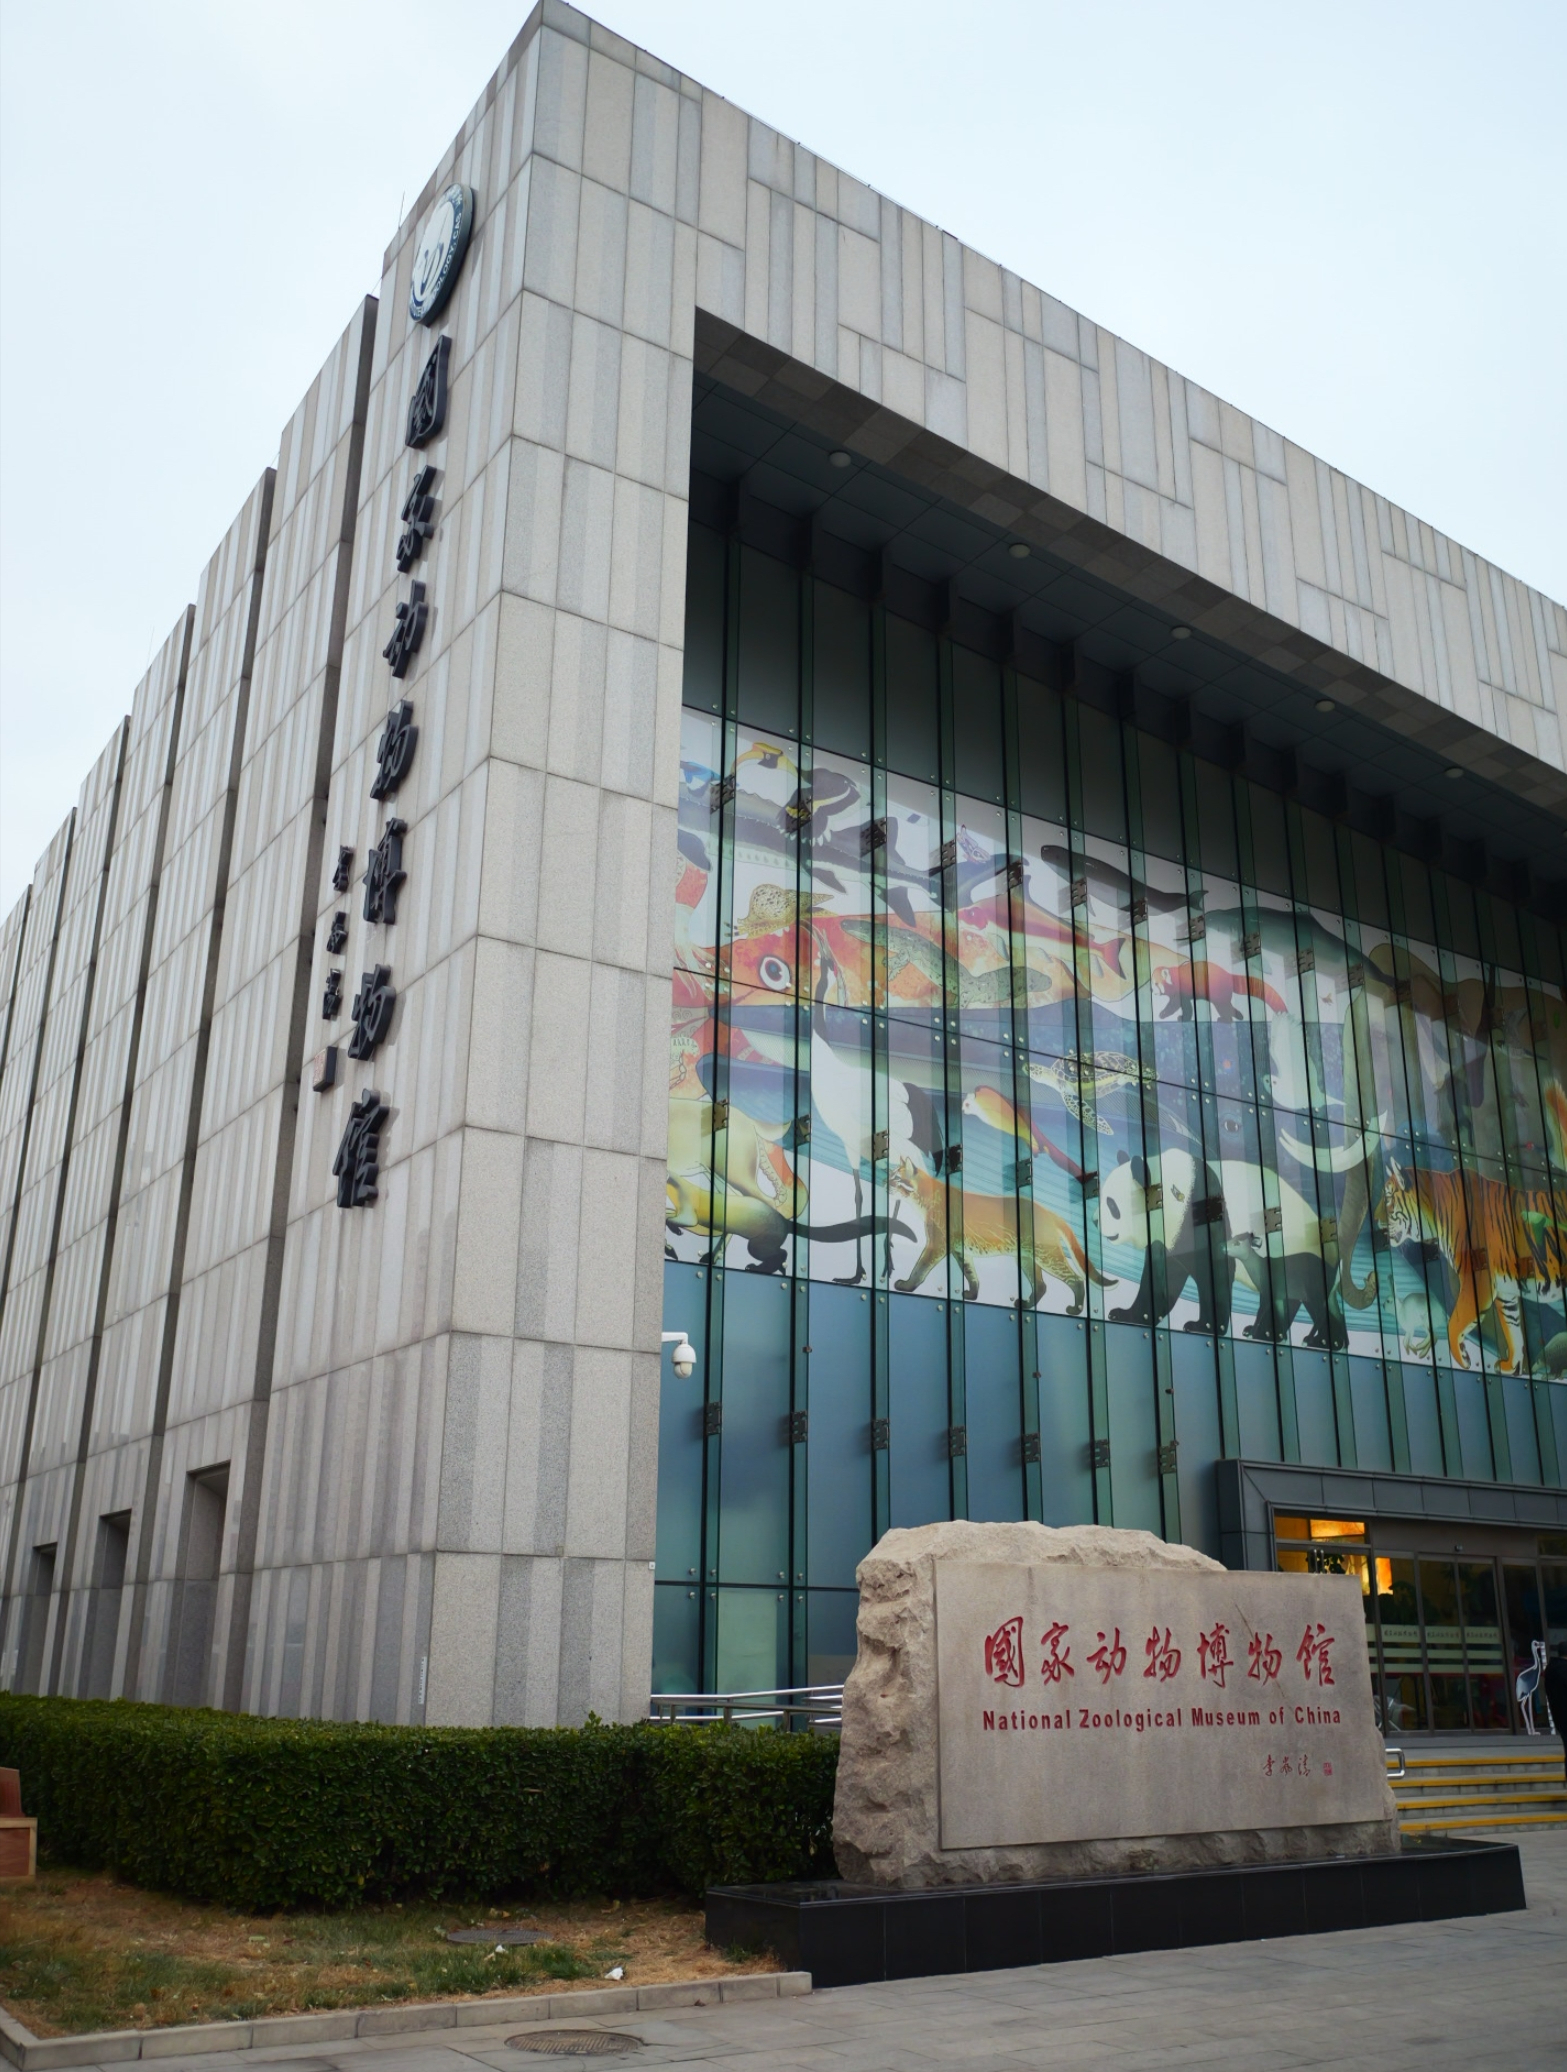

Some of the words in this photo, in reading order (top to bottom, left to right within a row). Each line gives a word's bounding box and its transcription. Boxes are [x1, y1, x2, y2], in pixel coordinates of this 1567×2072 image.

[982, 1707, 1071, 1731] National
[1079, 1706, 1182, 1733] Zoological
[1191, 1705, 1260, 1726] Museum
[1269, 1705, 1285, 1725] of
[1294, 1704, 1341, 1725] China
